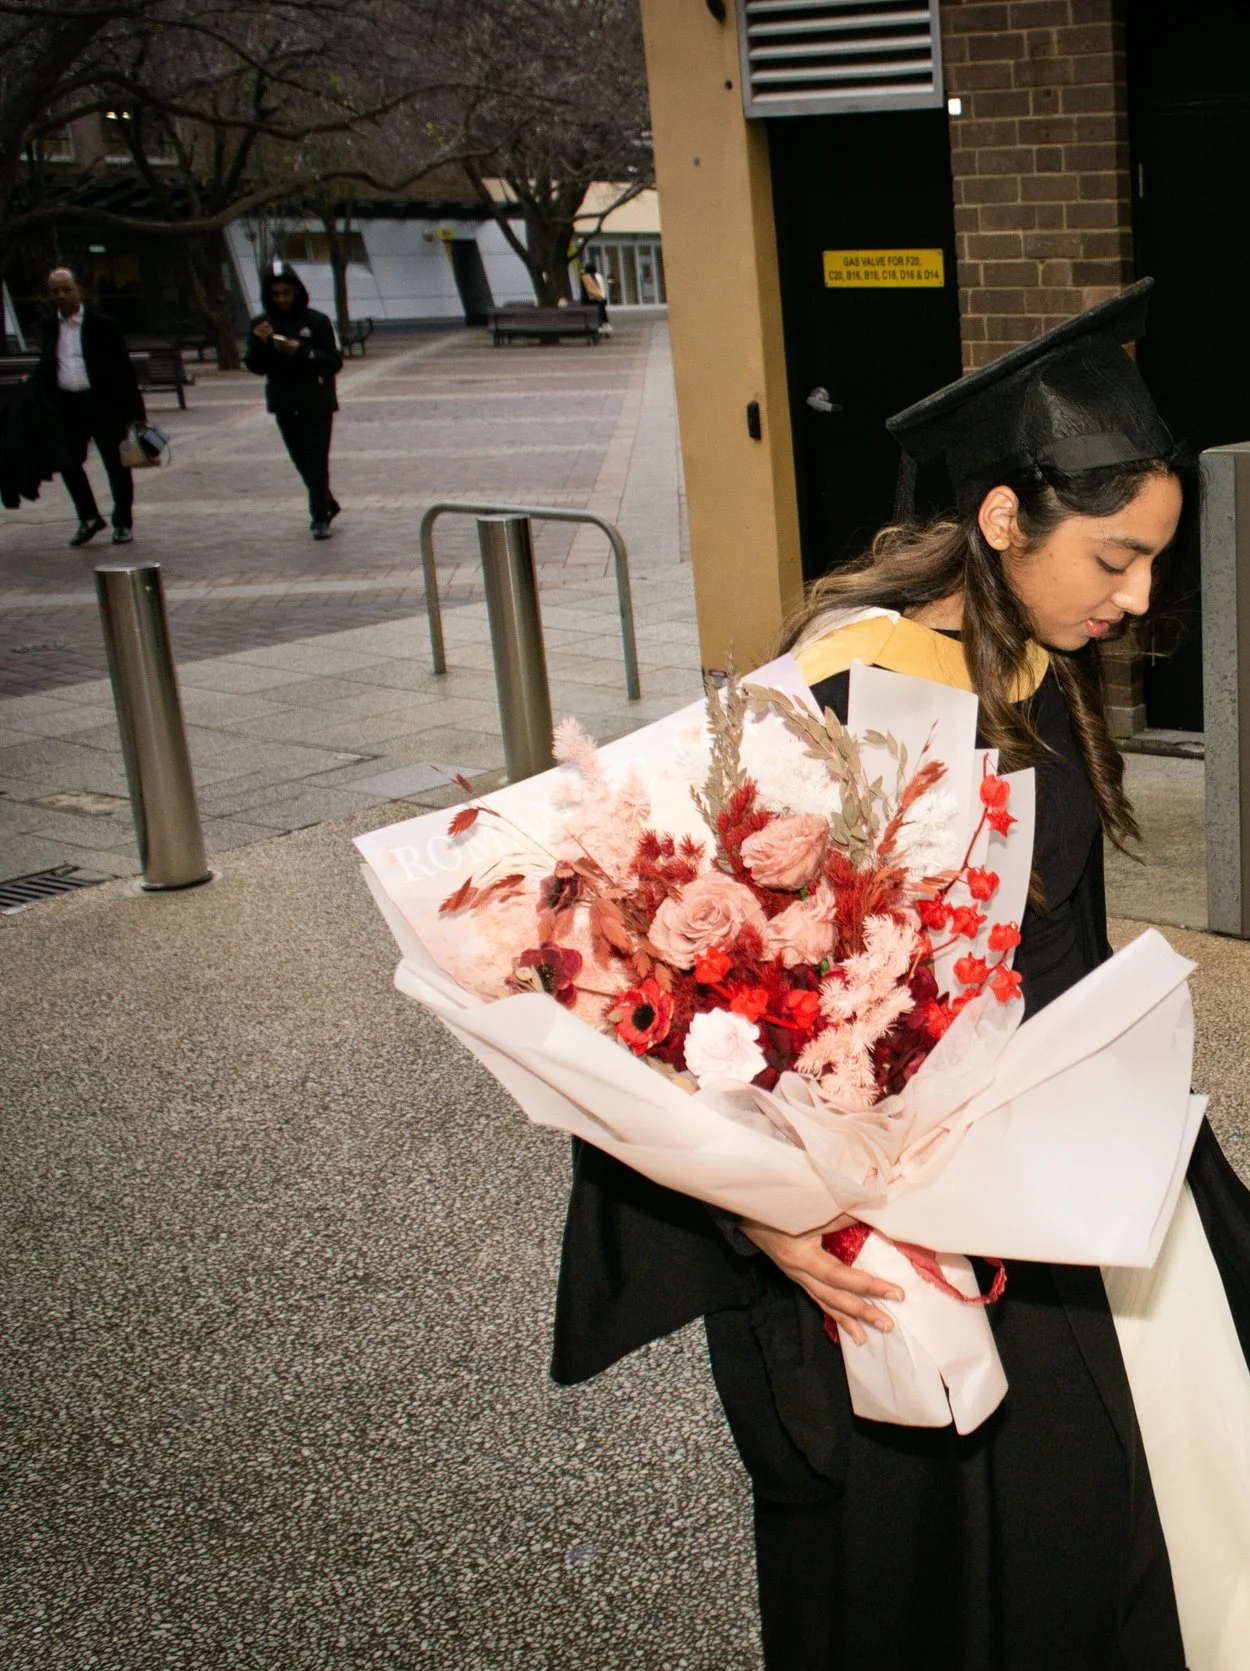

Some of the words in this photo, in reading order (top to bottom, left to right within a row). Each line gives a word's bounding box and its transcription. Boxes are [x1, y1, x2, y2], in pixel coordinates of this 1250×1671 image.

[843, 256, 860, 267] GAS
[861, 256, 886, 267] VALVE
[887, 256, 905, 267] FOR
[916, 269, 923, 280] &
